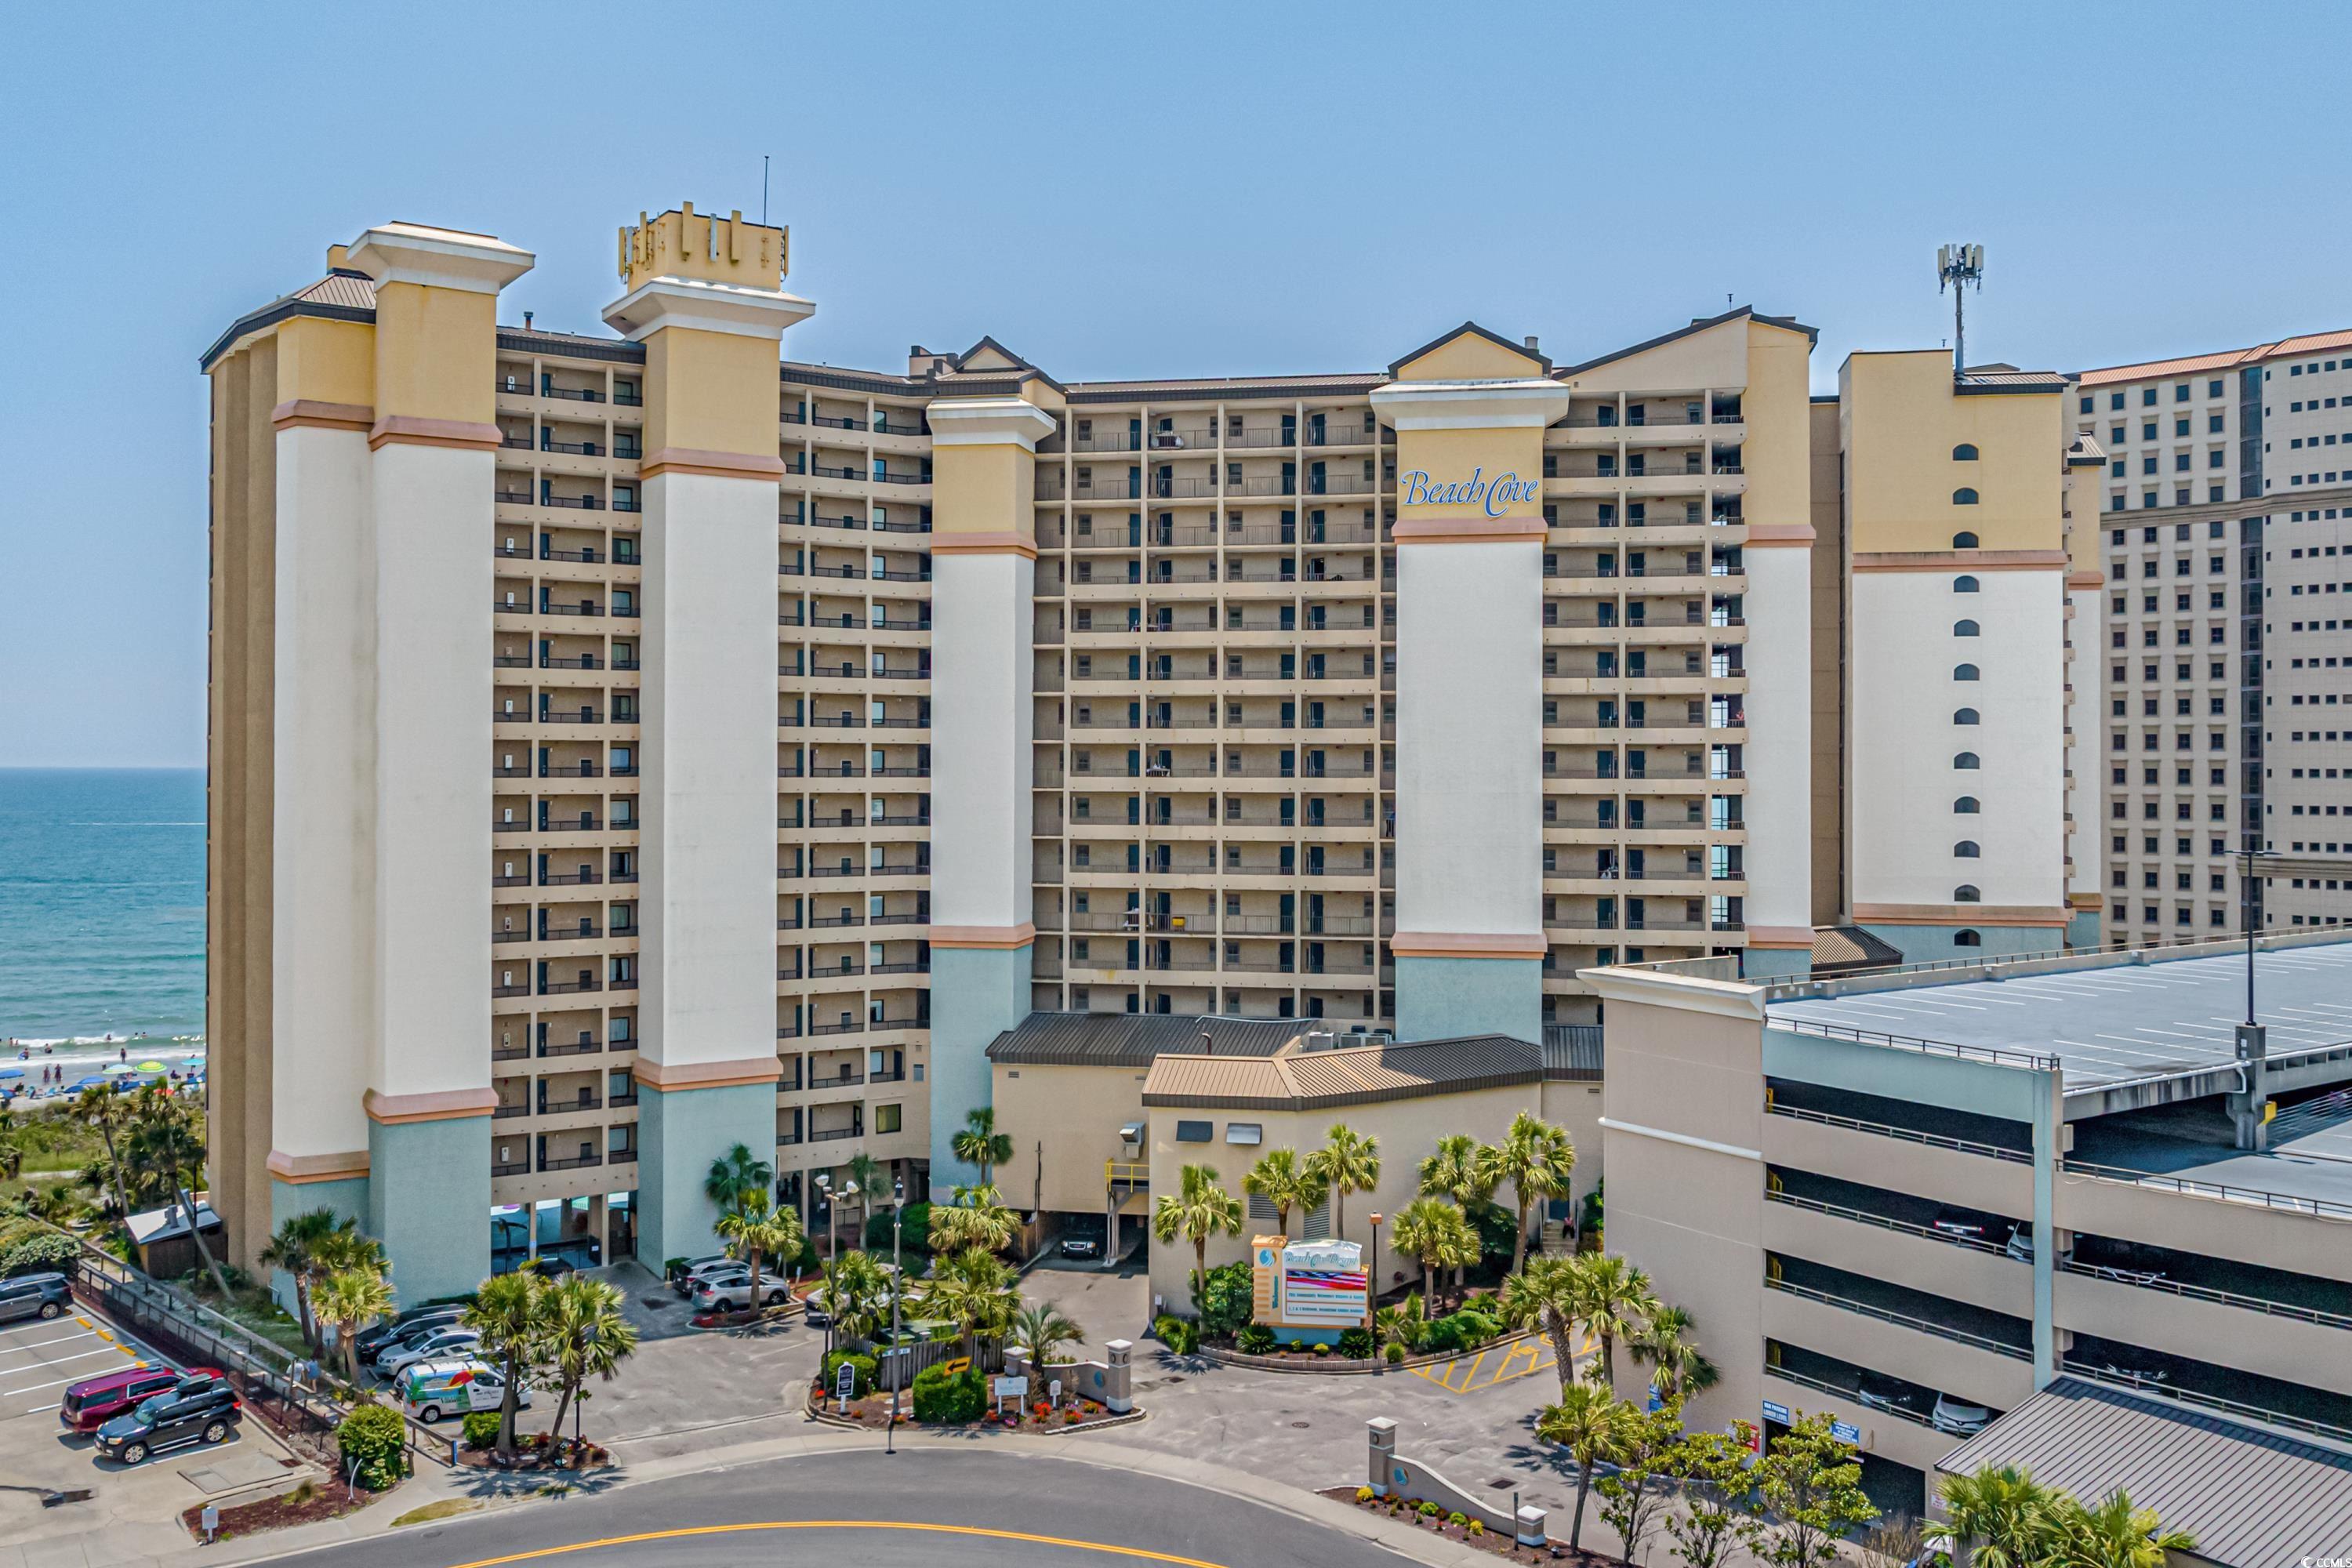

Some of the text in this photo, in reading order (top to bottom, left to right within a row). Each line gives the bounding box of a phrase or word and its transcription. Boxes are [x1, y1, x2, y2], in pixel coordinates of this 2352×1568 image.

[1401, 466, 1538, 517] Beach Cove
[1777, 1412, 1788, 1422] LEVEL
